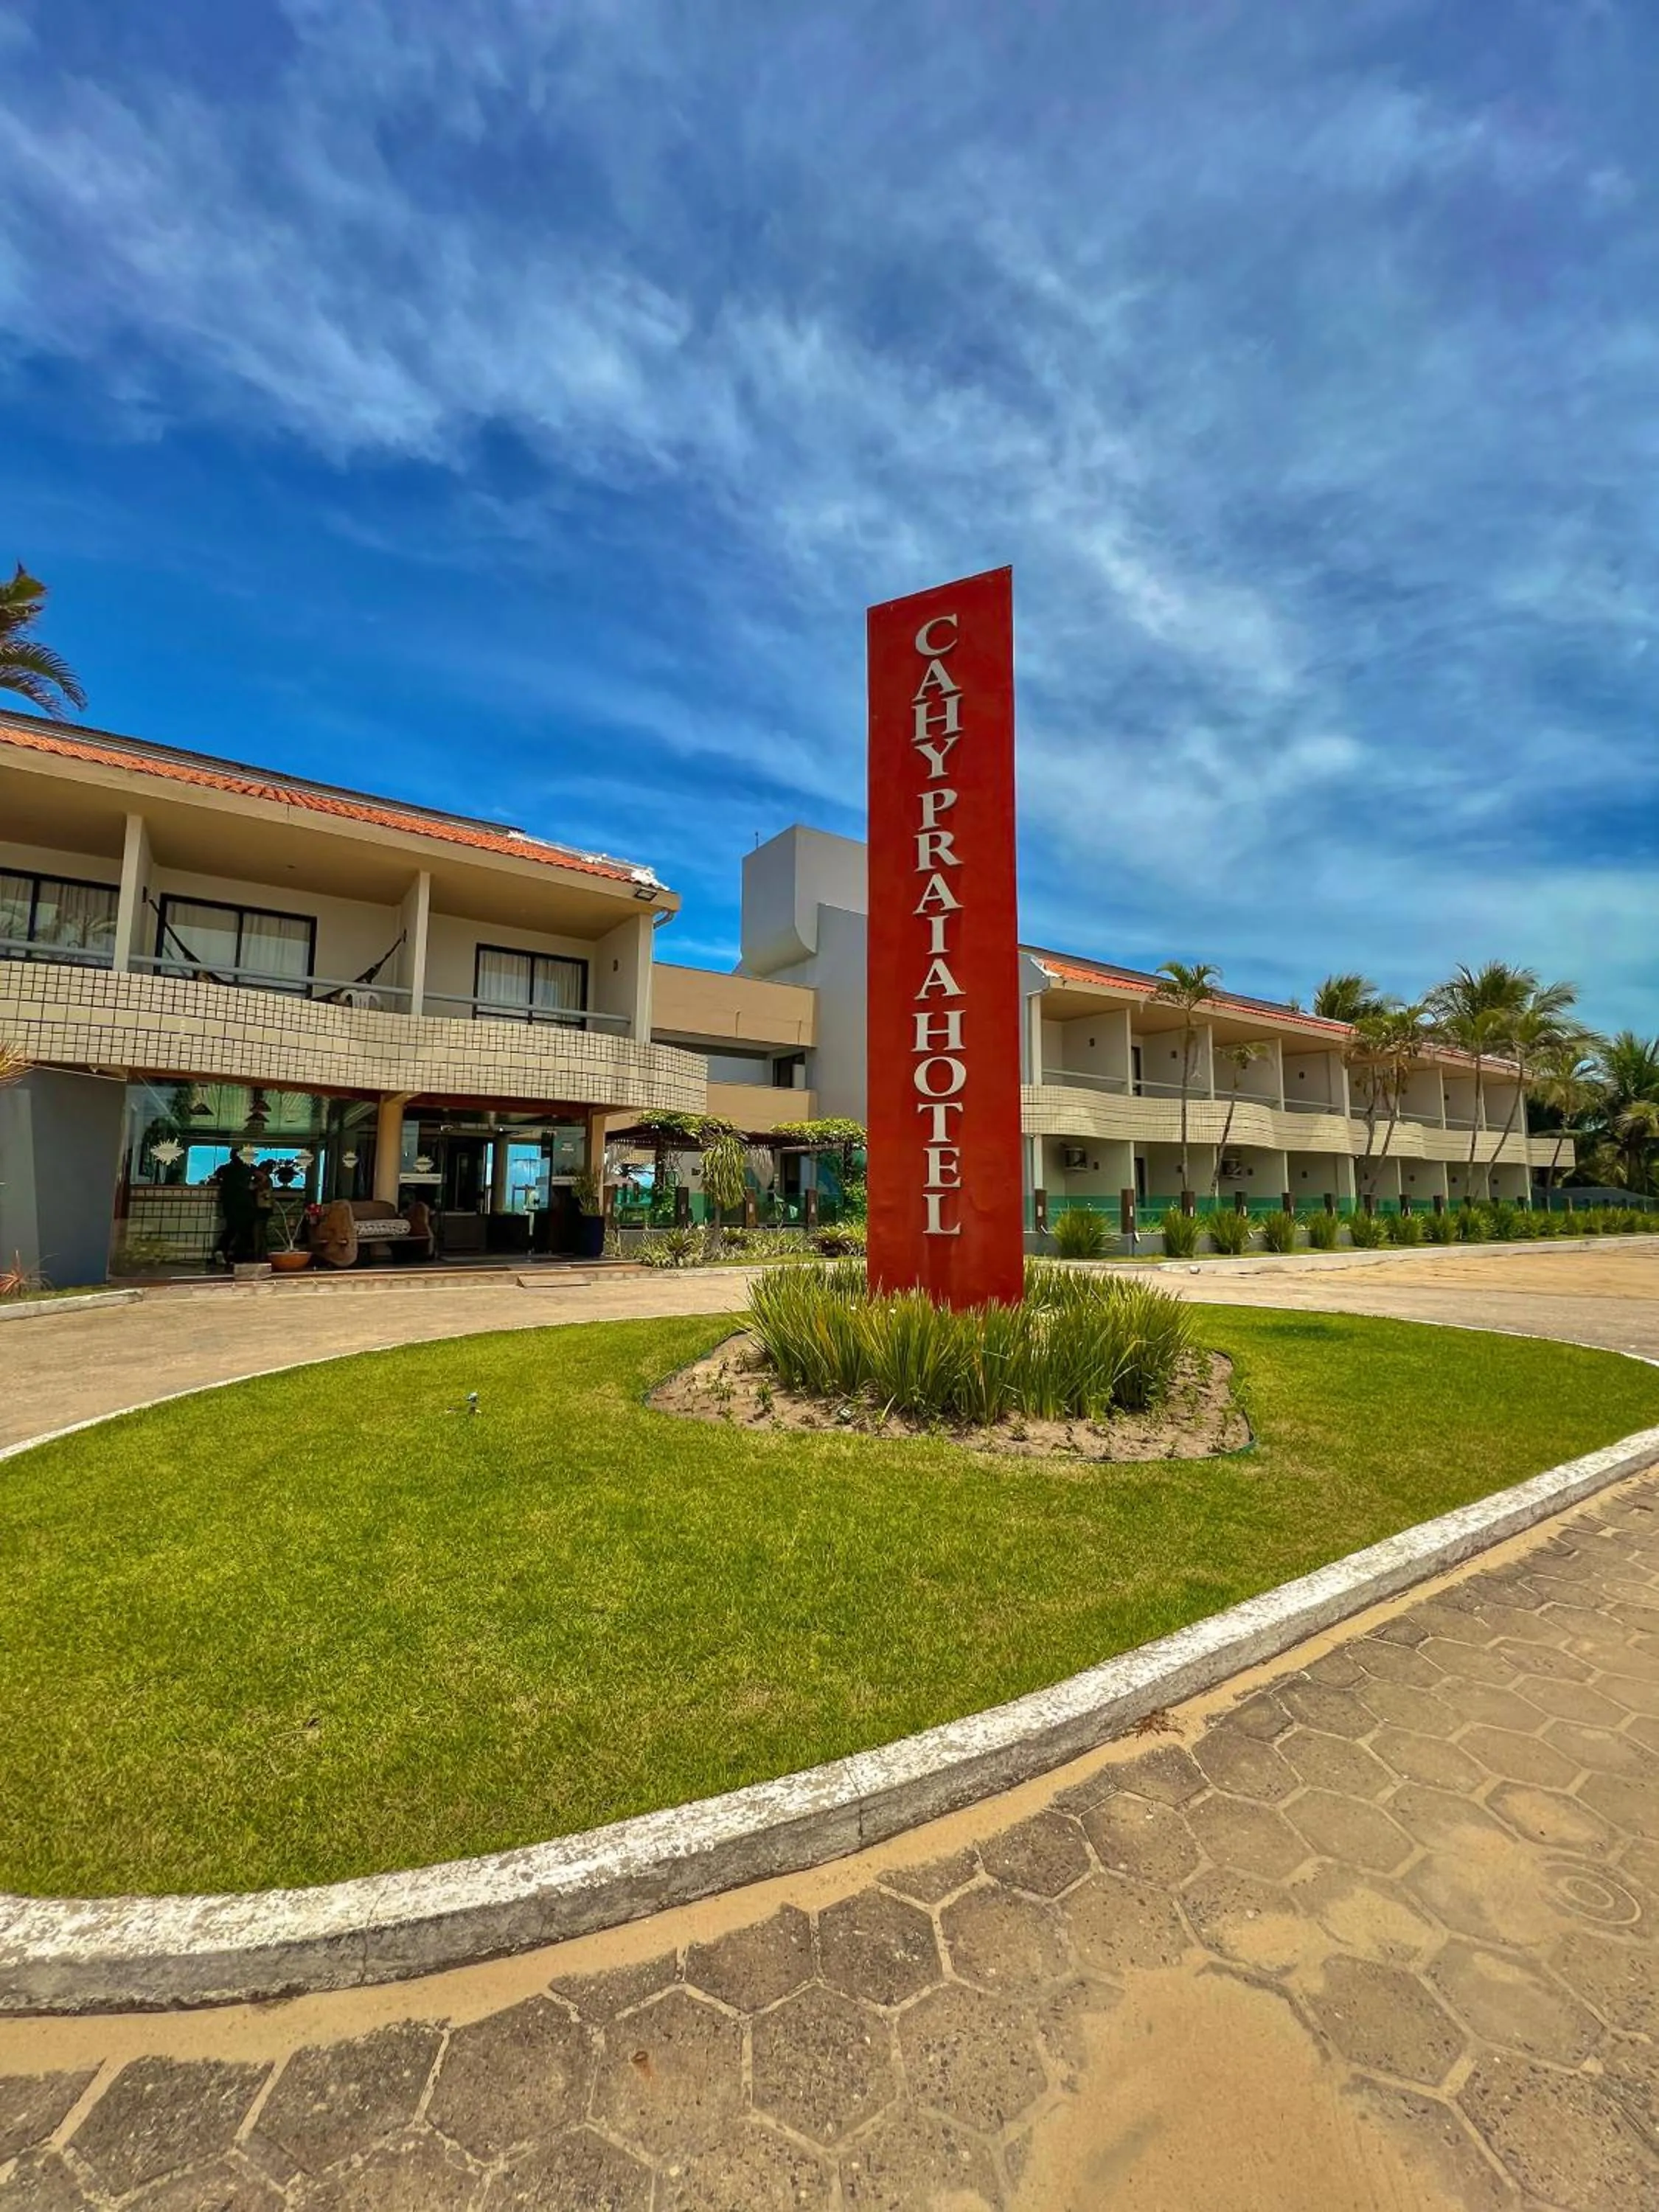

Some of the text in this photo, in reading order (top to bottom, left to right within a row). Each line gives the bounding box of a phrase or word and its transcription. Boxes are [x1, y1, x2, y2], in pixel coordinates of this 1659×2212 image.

[911, 613, 967, 1236] CAHY PRAIA HOTEL
